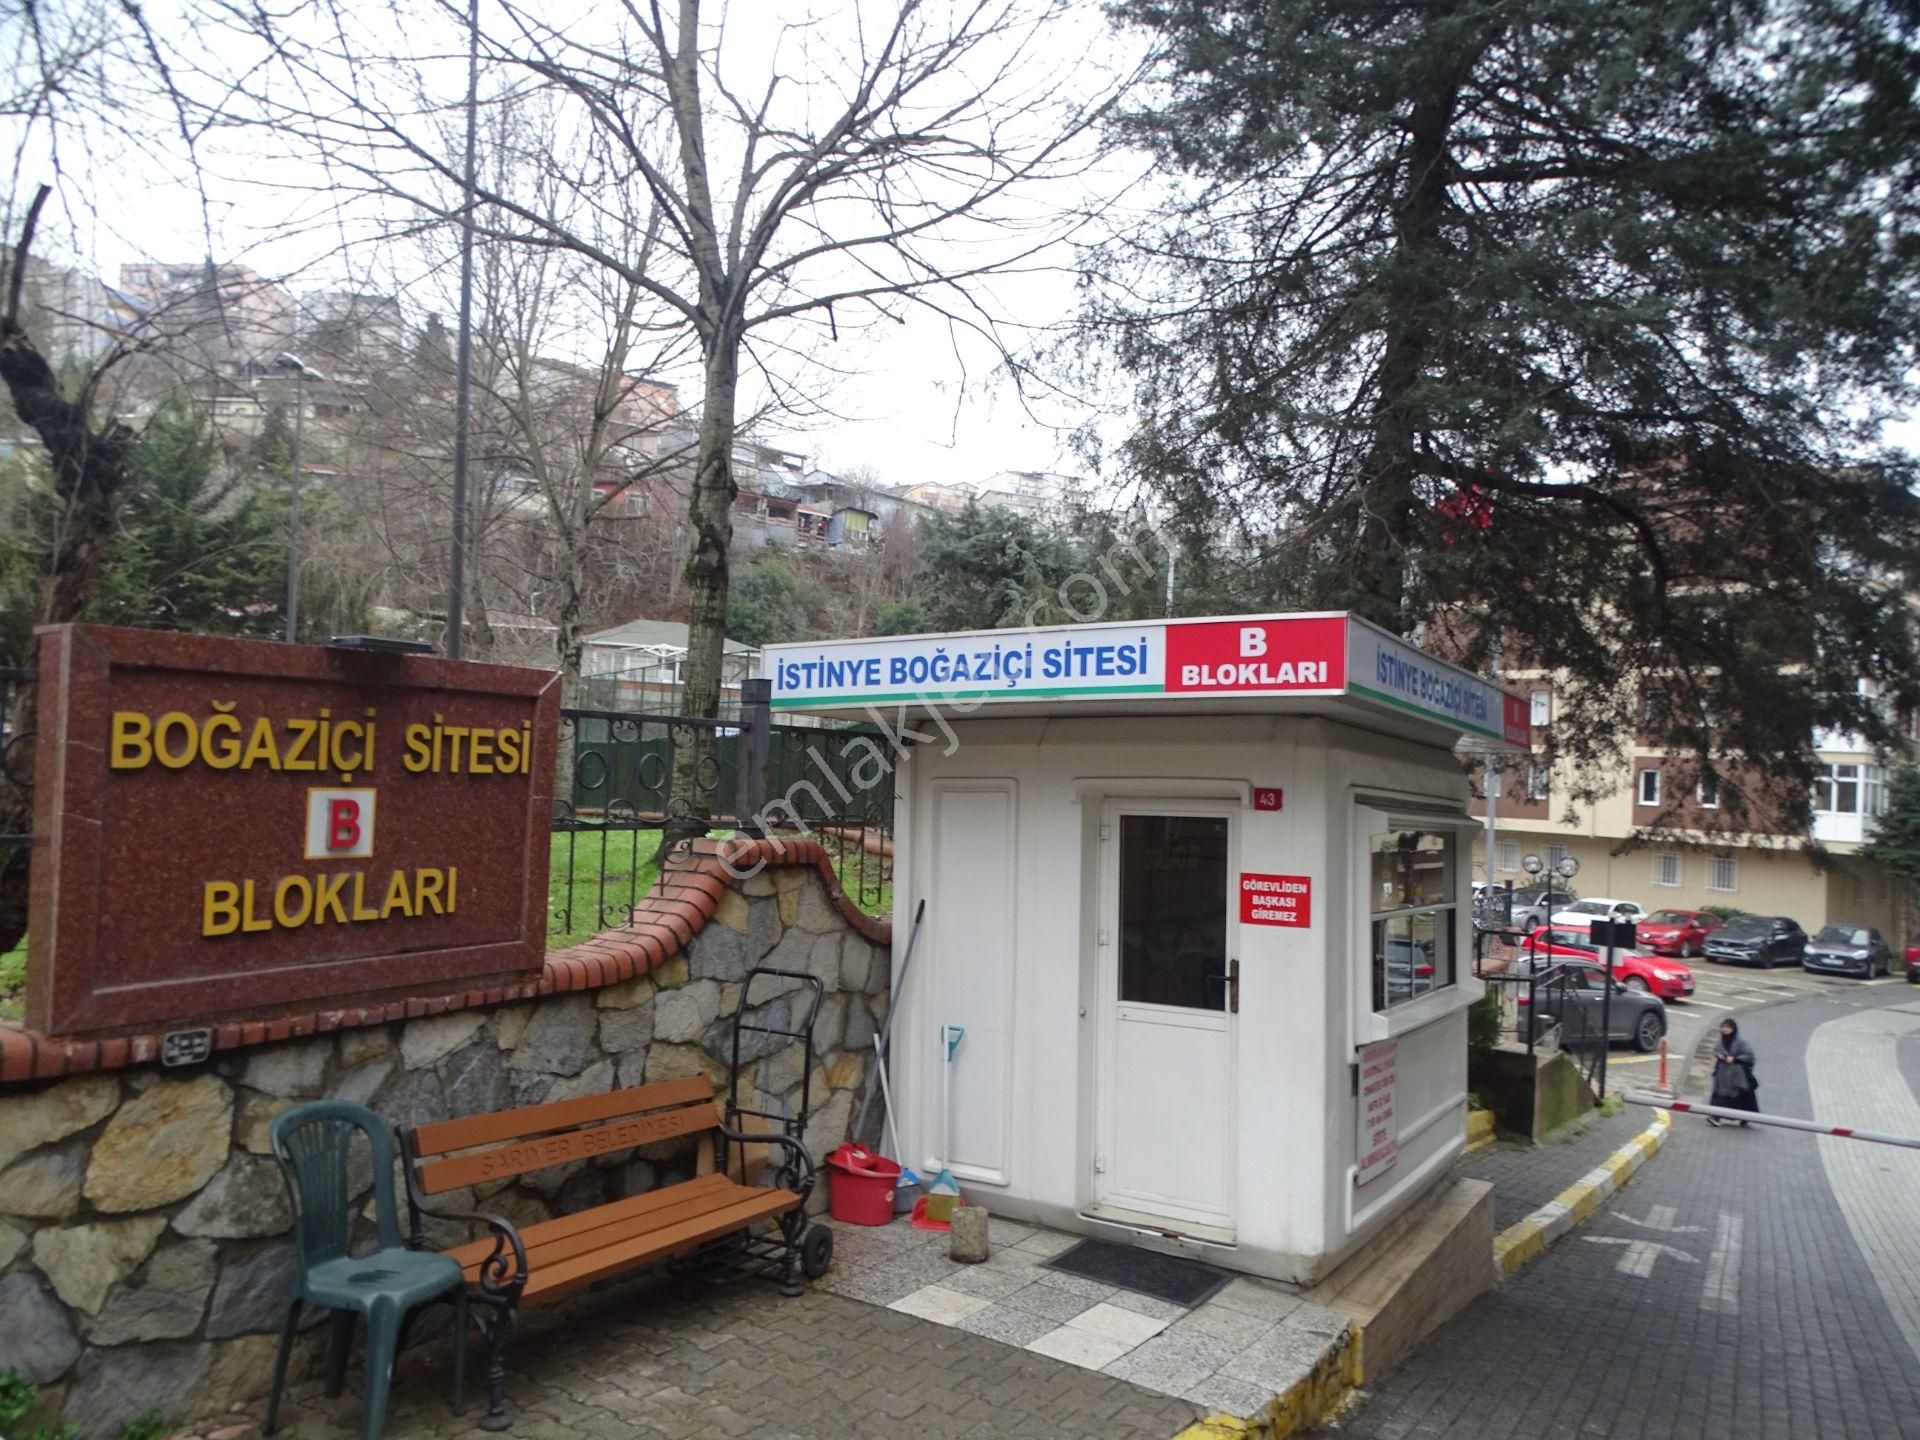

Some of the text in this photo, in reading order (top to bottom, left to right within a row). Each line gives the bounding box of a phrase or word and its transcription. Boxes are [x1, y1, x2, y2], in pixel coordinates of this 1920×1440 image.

[1240, 627, 1268, 657] B
[777, 637, 1147, 690] İSTİNYE BOĞAZİÇİ SİTESİ
[1182, 661, 1328, 686] BLOKLARI
[1376, 642, 1418, 696] İSTİNYE
[110, 700, 531, 782] BOĞAZİÇİ SİTESİ
[1260, 793, 1276, 806] 43
[327, 798, 361, 850] B
[203, 866, 457, 936] BLOKLARI
[1242, 879, 1308, 894] GÖREVLİDEN
[1251, 894, 1297, 908] BAŞKASI
[1251, 908, 1298, 922] GİREMEZ
[480, 1114, 685, 1176] SARIYER BELEDİYESİ
